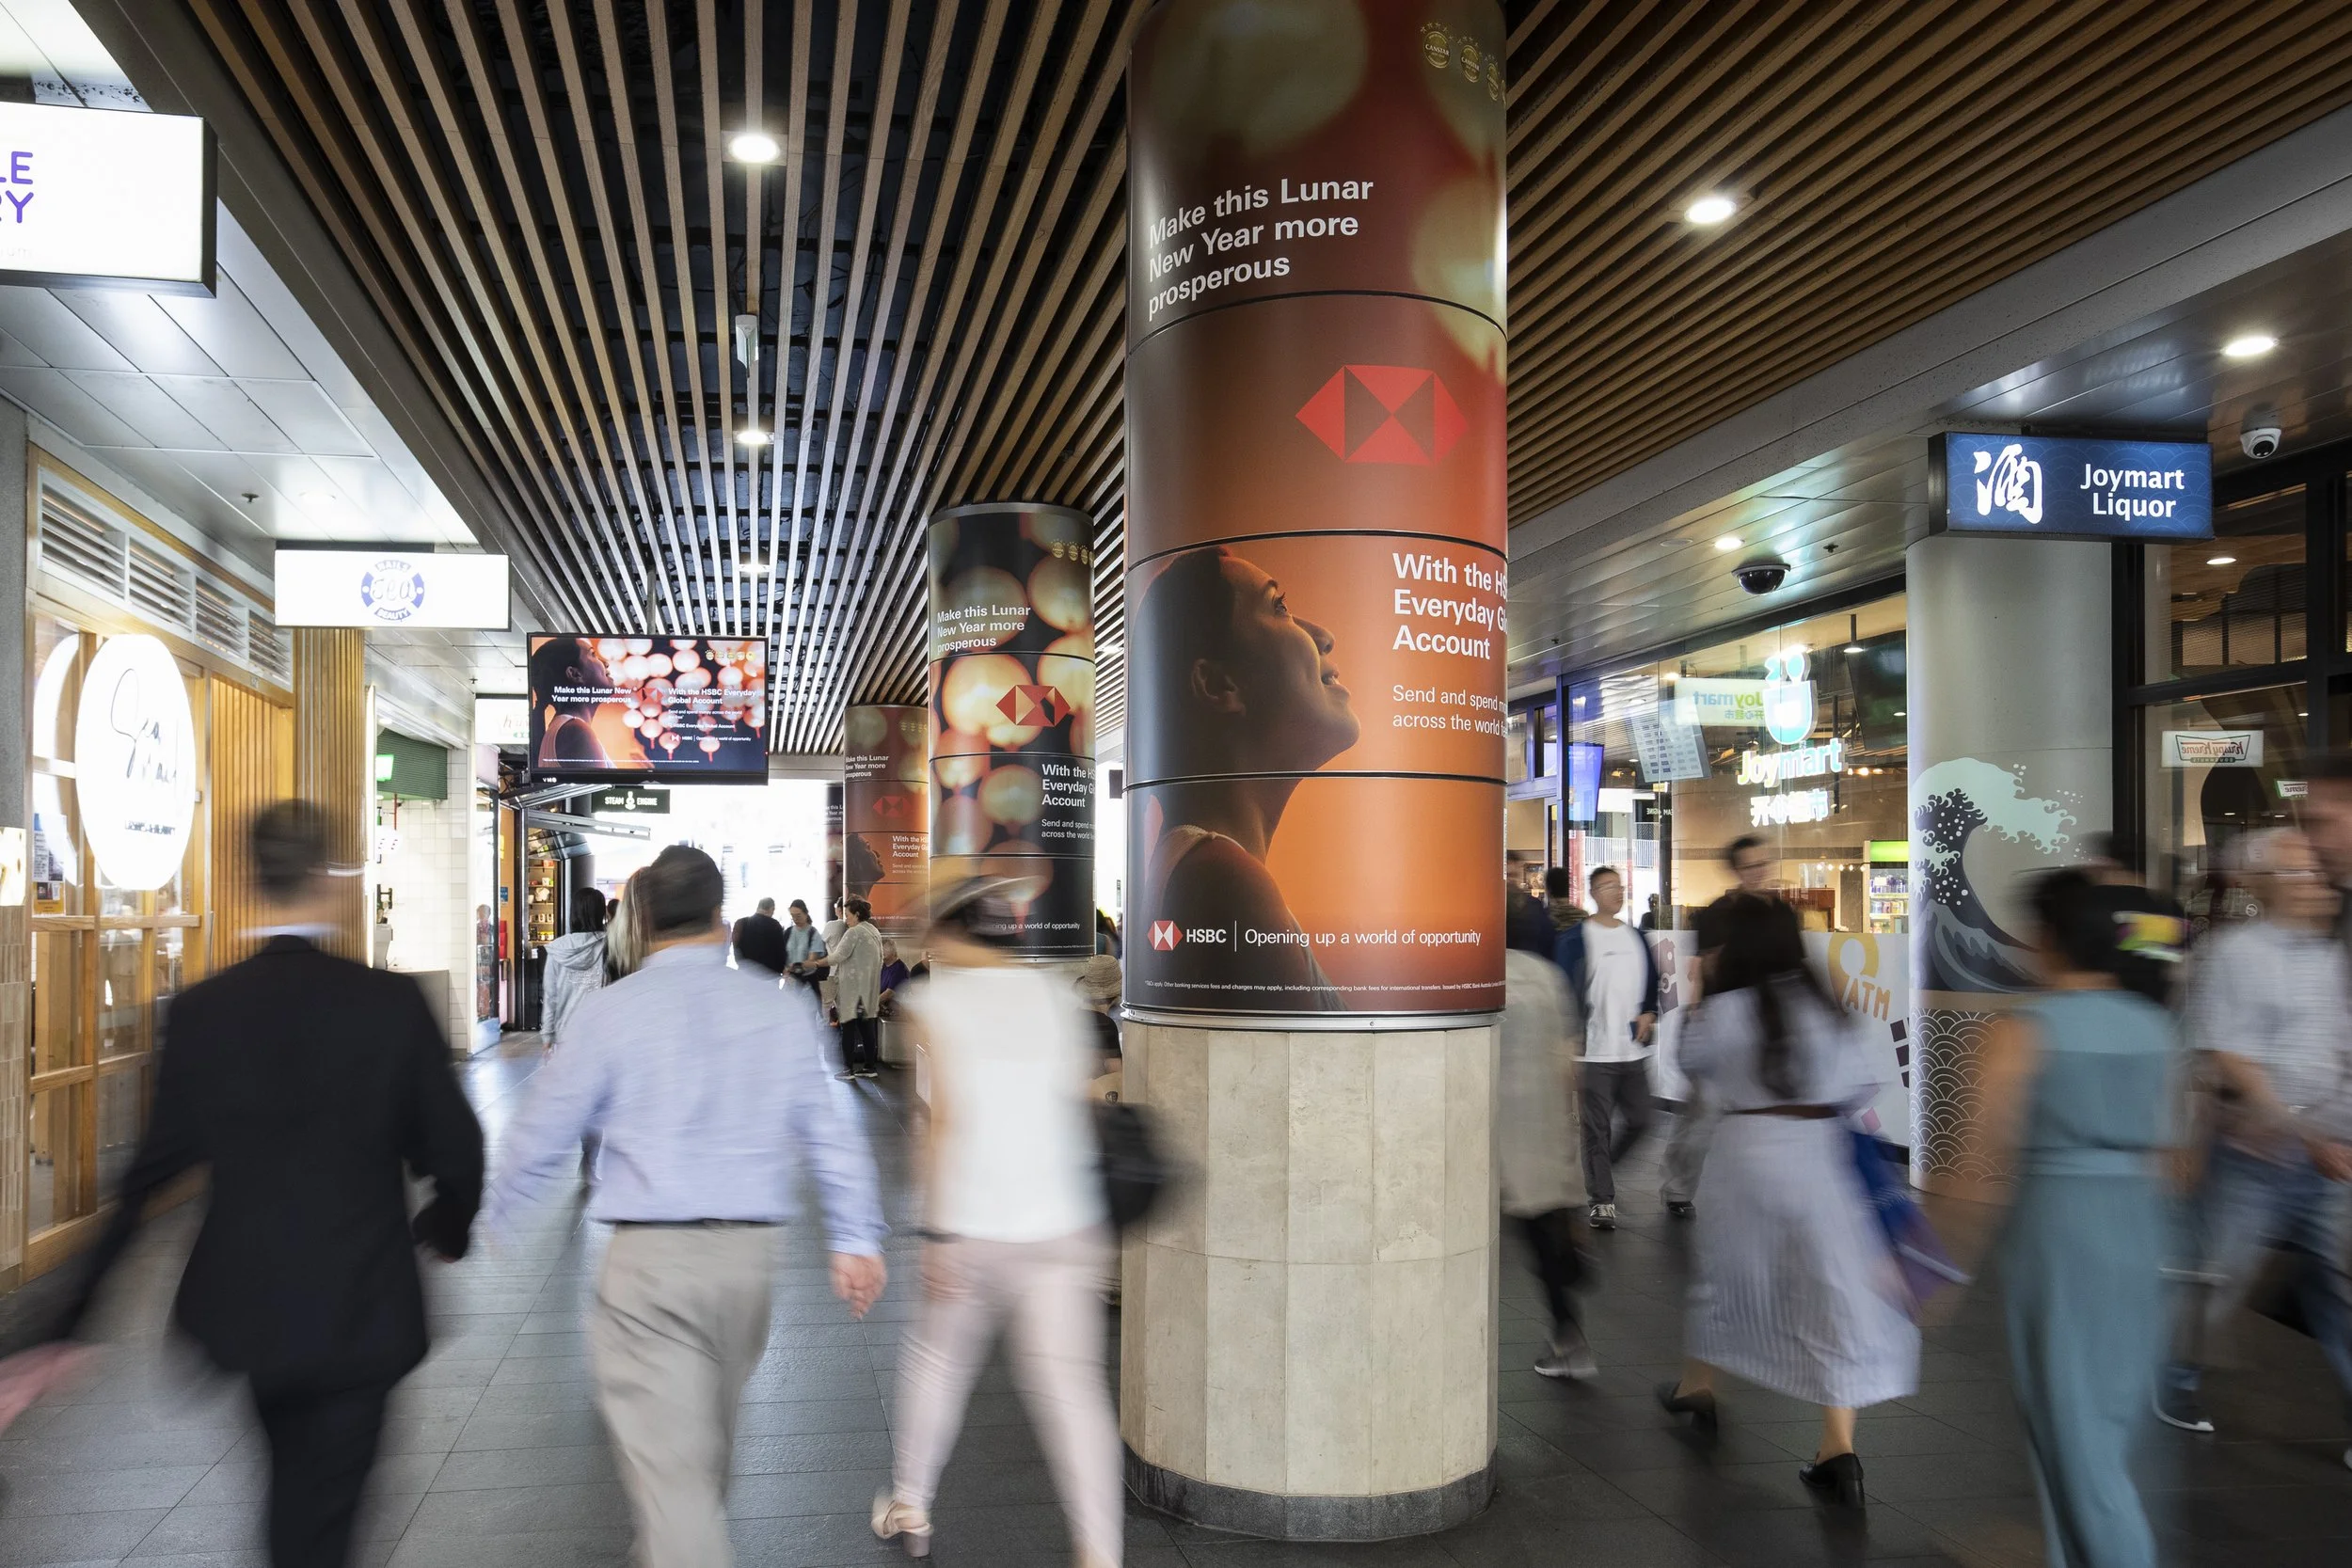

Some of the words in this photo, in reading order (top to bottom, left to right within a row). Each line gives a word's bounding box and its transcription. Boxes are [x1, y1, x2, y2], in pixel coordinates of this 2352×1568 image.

[1425, 43, 1450, 56] CANSTAR
[1150, 205, 1206, 248] Make
[1214, 185, 1269, 217] this
[1280, 178, 1374, 204] Lunar
[1149, 244, 1195, 282] New
[1201, 225, 1264, 255] Year
[1275, 216, 1359, 240] more
[1148, 256, 1290, 322] prosperous
[2080, 464, 2185, 492] Joymart
[2092, 492, 2176, 521] Liquor
[1392, 553, 1456, 584] With
[1464, 562, 1492, 591] the
[937, 610, 961, 624] Make
[963, 605, 988, 618] this
[992, 604, 1031, 616] Lunar
[1394, 589, 1494, 632] Everyday
[937, 625, 957, 639] New
[959, 622, 986, 633] Year
[990, 622, 1025, 631] more
[937, 638, 997, 656] prosperous
[1392, 625, 1490, 660] Account
[576, 686, 591, 694] this
[723, 689, 756, 697] Everyday
[1392, 685, 1435, 703] Send
[1440, 689, 1466, 705] and
[1470, 694, 1498, 711] spend
[668, 696, 691, 705] Global
[1392, 714, 1446, 729] across
[1451, 714, 1471, 731] the
[1474, 719, 1500, 736] world
[1041, 764, 1071, 776] With
[1073, 767, 1087, 778] the
[1738, 737, 1843, 787] Joymart
[1042, 779, 1088, 796] Everyday
[605, 796, 624, 805] STEAM
[636, 797, 658, 806] ENGINE
[1041, 794, 1086, 807] Account
[1041, 818, 1060, 827] Send
[1075, 821, 1089, 830] spend
[1077, 832, 1089, 840] world
[1051, 923, 1081, 931] opportunity
[1186, 928, 1227, 943] HSBC
[1245, 928, 1310, 947] Opening
[1315, 932, 1335, 947] up
[1341, 933, 1350, 943] a
[1355, 929, 1397, 943] world
[1402, 929, 1416, 943] of
[1420, 929, 1481, 947] opportunity
[1845, 977, 1891, 1022] ATM
